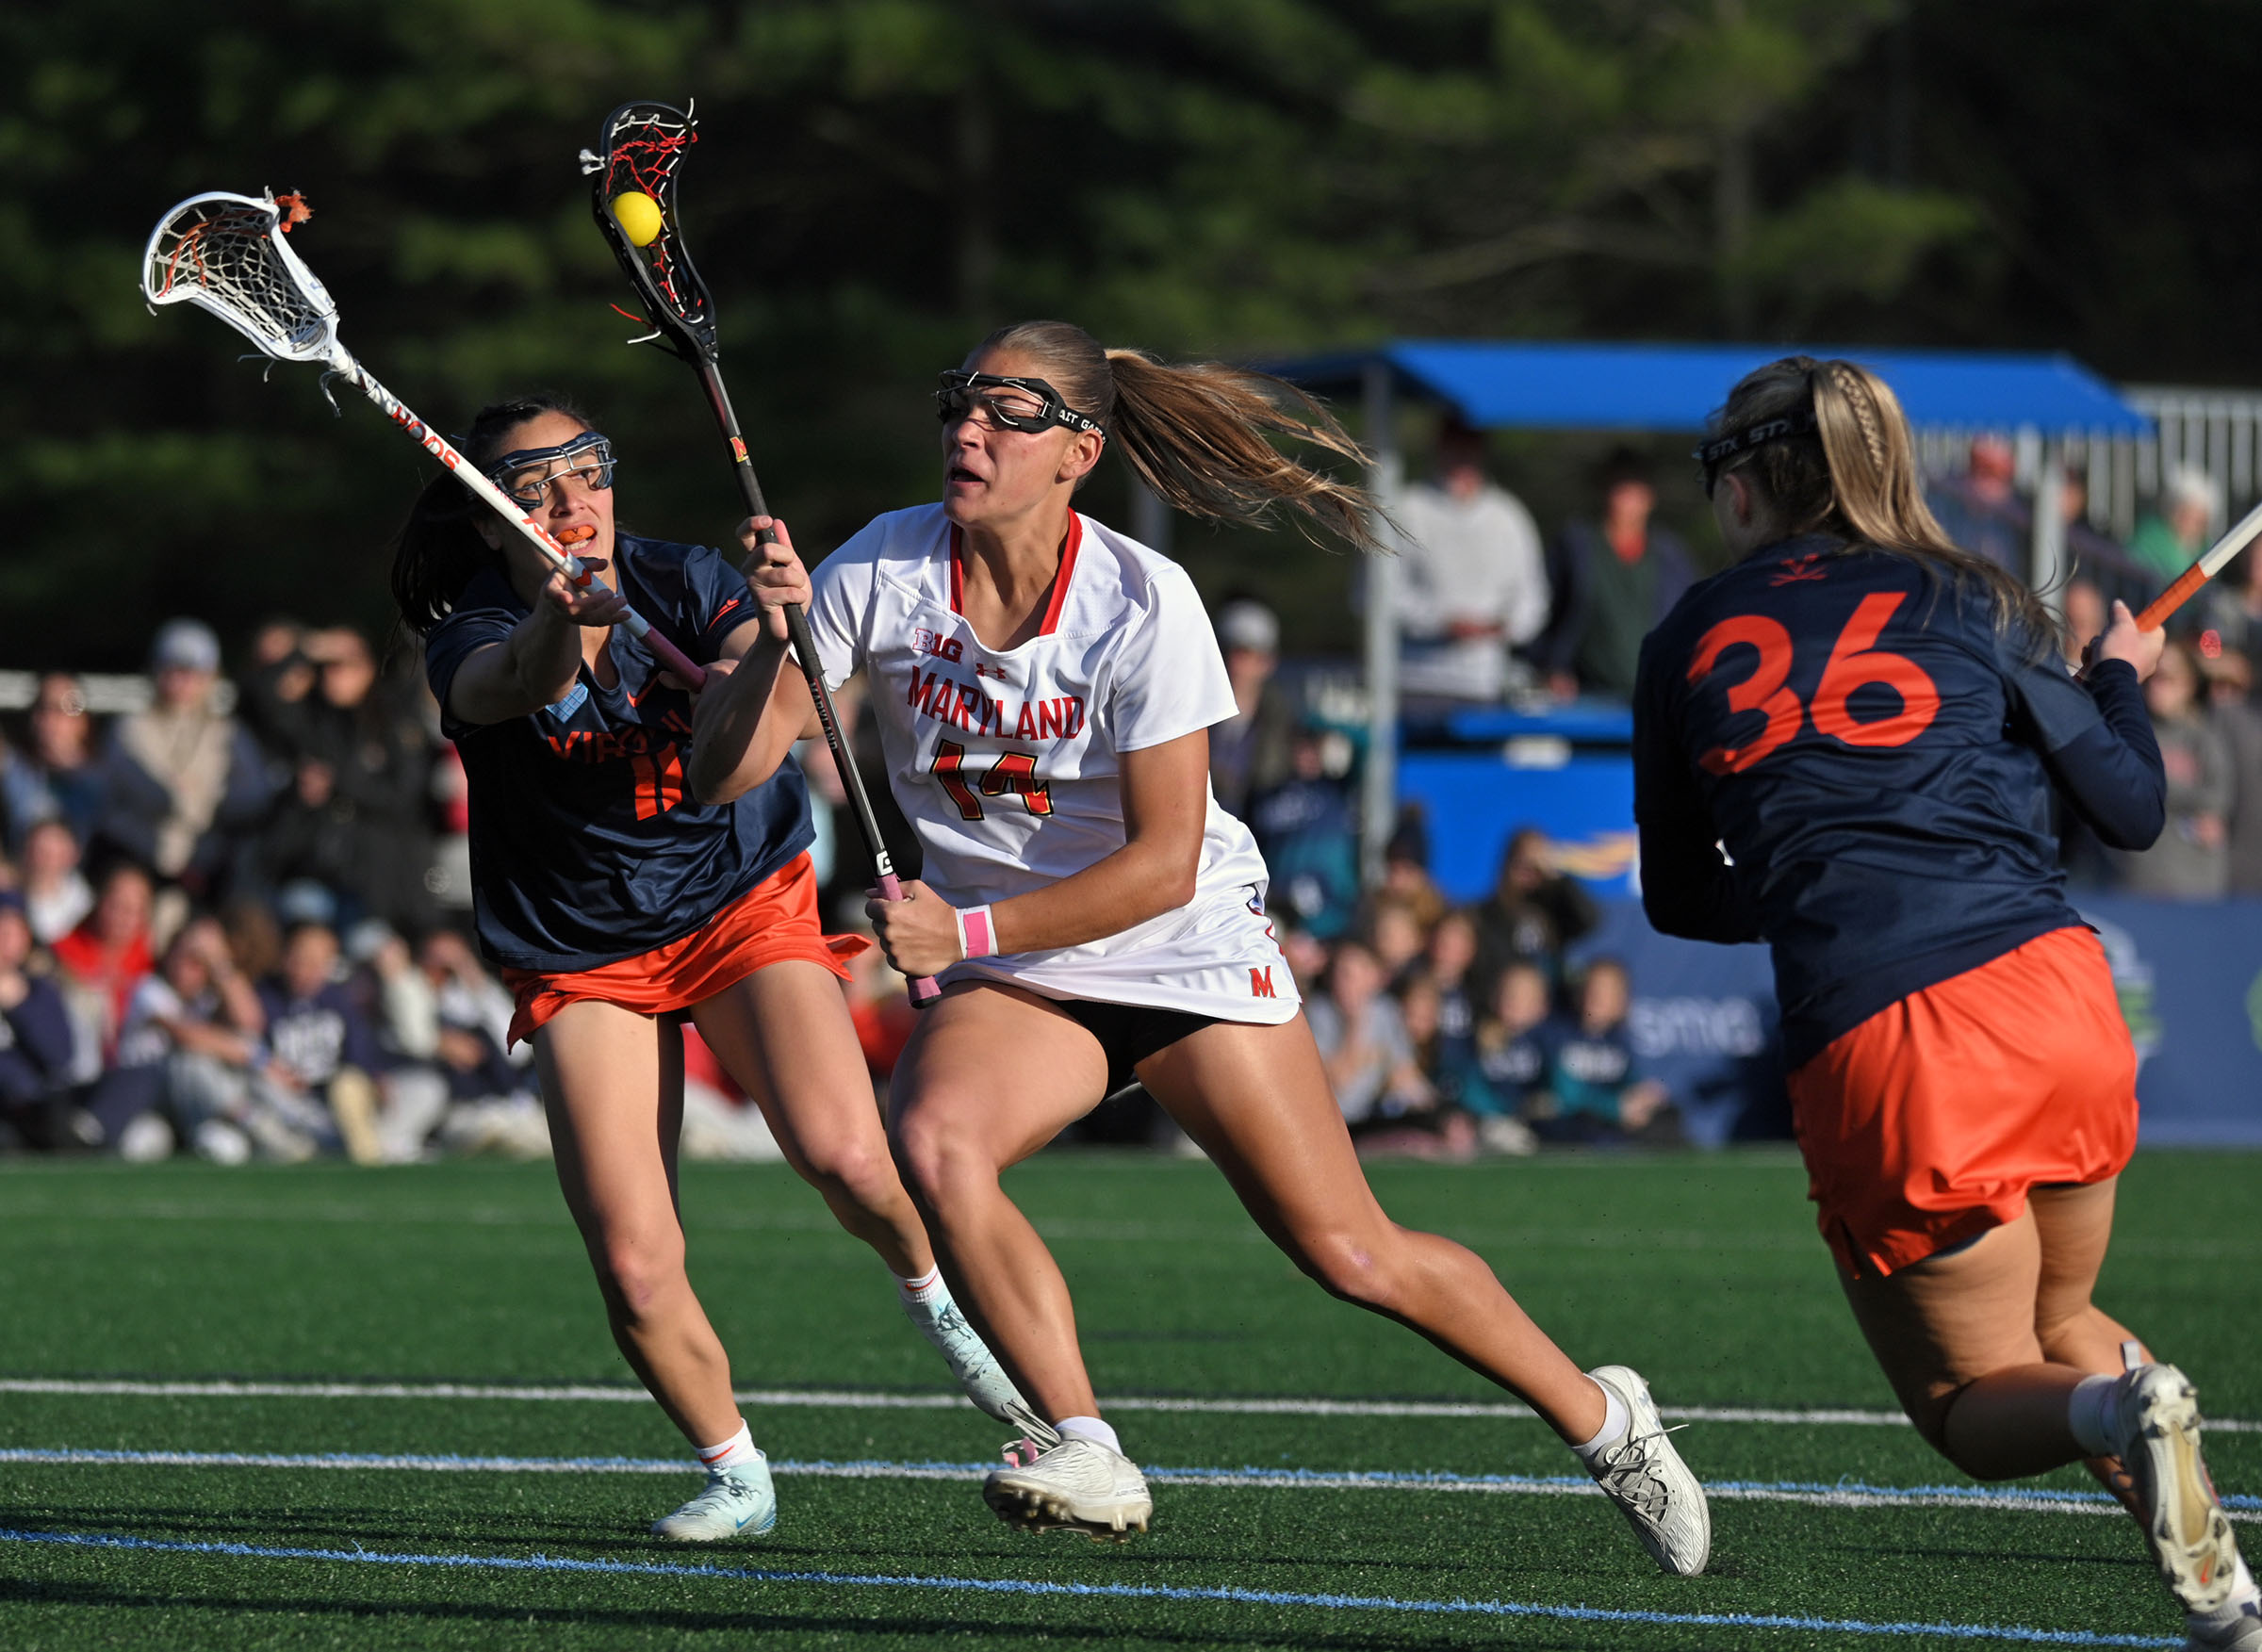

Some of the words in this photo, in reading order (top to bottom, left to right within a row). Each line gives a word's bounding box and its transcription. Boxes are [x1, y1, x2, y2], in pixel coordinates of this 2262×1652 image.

[907, 665, 1085, 742] MARYLAND
[1686, 591, 1942, 777] 36
[929, 738, 1054, 821] 14
[1249, 965, 1276, 999] M
